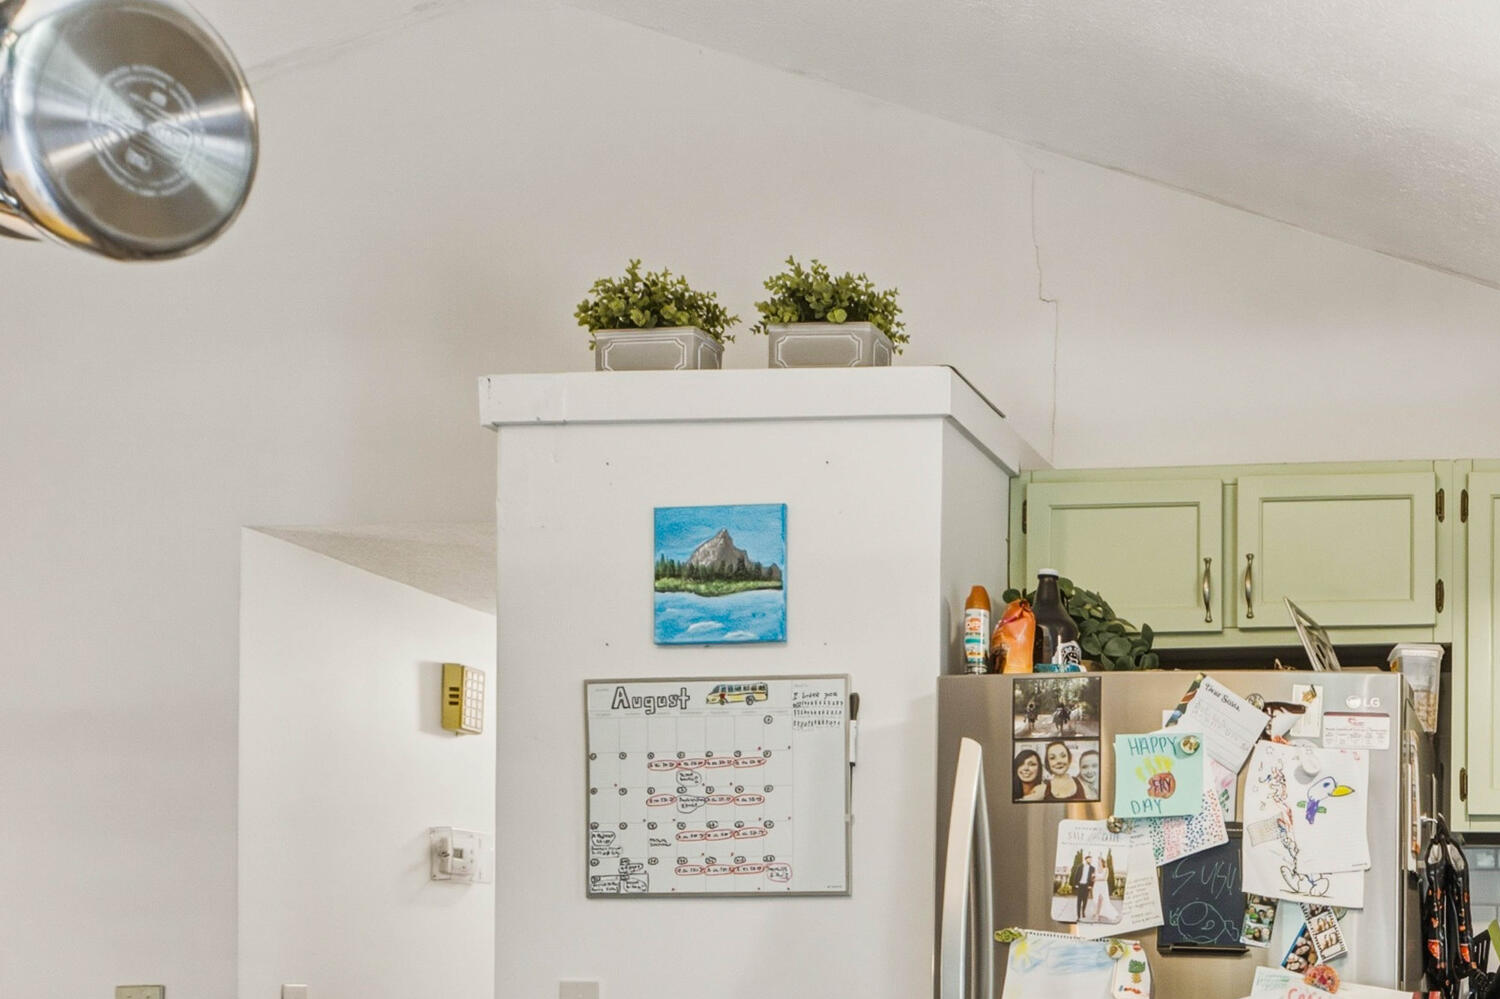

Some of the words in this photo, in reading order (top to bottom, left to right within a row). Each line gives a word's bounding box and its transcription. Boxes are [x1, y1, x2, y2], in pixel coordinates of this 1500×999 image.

[611, 686, 691, 715] August
[1363, 697, 1381, 708] LG
[1128, 736, 1178, 756] HAPPY
[1131, 798, 1162, 815] DAY
